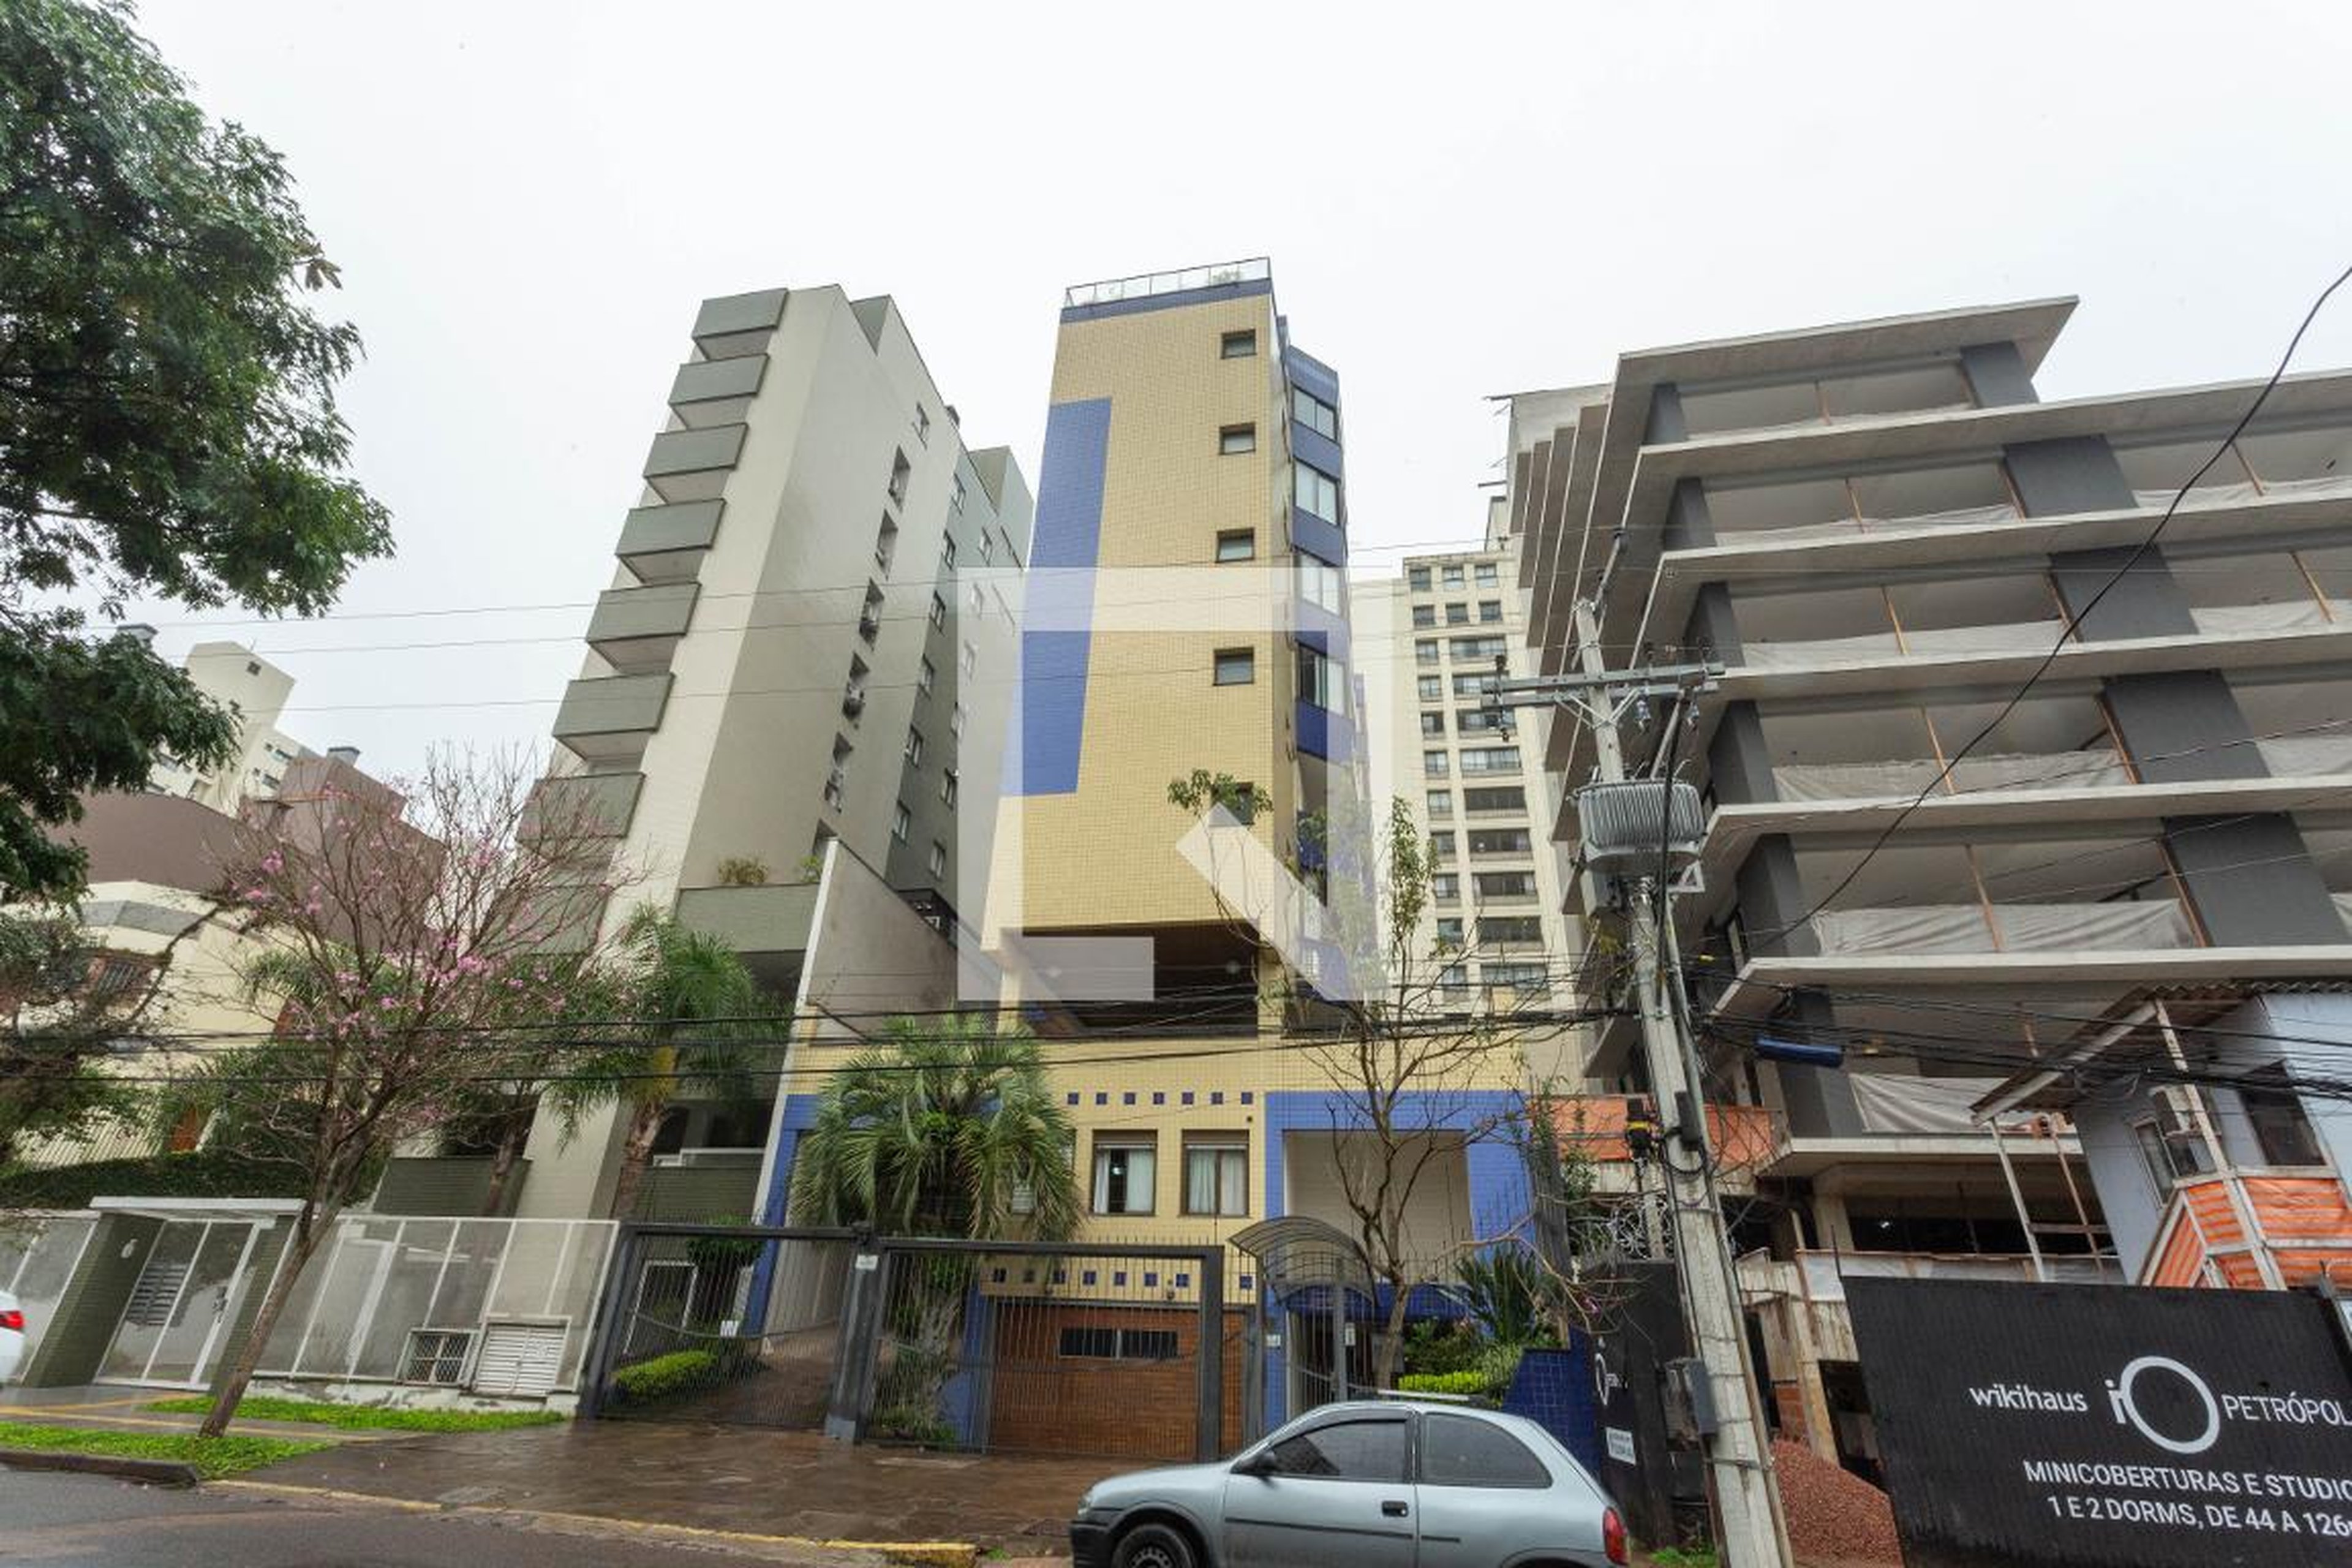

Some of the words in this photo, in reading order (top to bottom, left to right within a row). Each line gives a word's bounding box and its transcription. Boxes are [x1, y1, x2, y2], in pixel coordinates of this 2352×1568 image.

[1969, 1383, 2089, 1412] wikihaus
[2022, 1460, 2241, 1493] MINICOBERTURAS
[2242, 1472, 2263, 1495] E
[2047, 1496, 2062, 1517] 1
[2067, 1496, 2085, 1518] E
[2086, 1496, 2105, 1520] 2
[2104, 1498, 2204, 1530] DORMS,
[2204, 1504, 2242, 1529] DE
[2245, 1507, 2277, 1531] 44
[2282, 1510, 2301, 1532] A
[2302, 1512, 2352, 1537] 126
